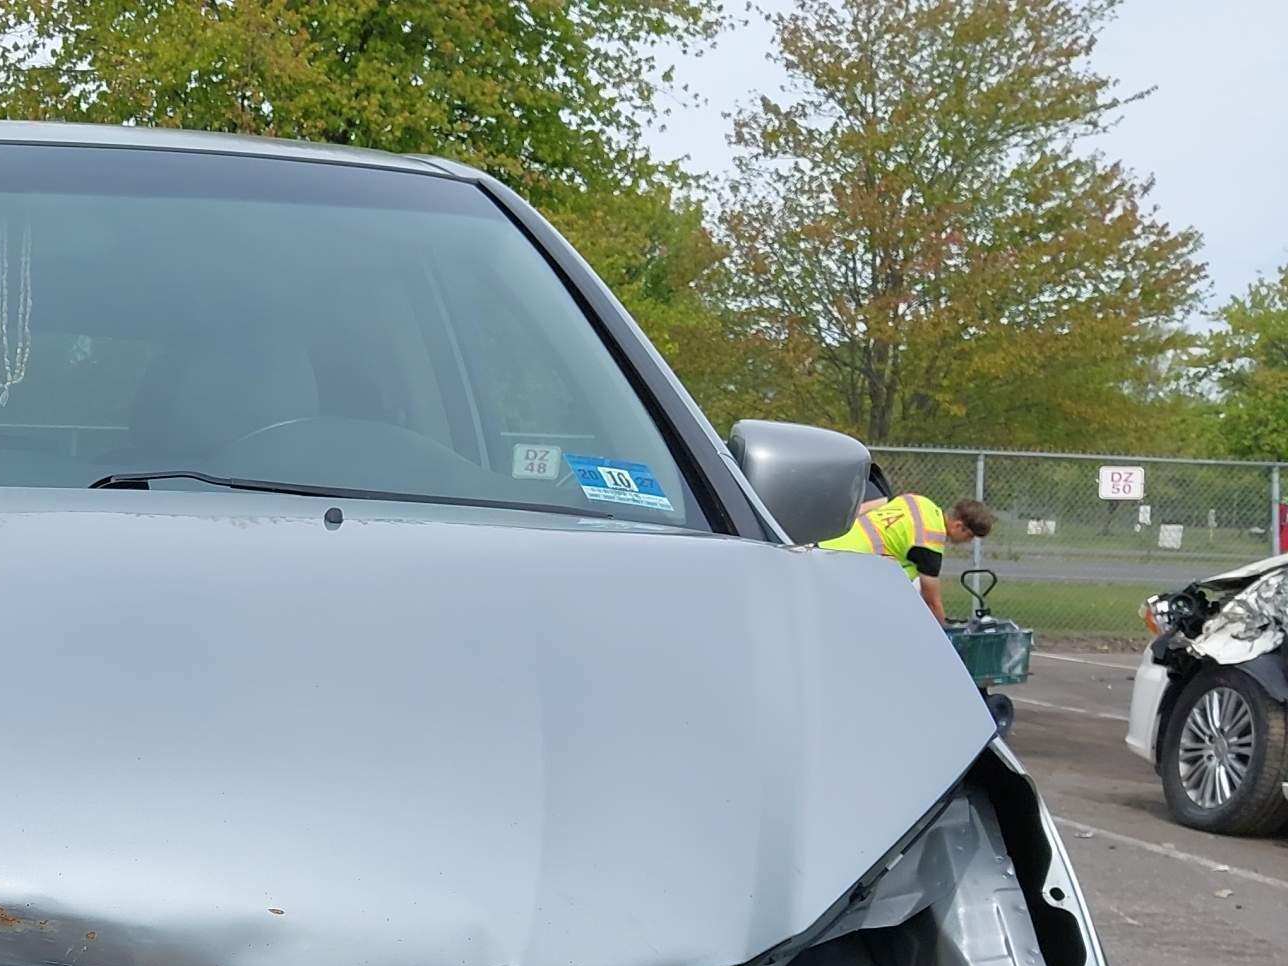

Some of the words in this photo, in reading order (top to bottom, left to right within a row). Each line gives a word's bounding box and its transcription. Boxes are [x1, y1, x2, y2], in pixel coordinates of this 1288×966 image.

[523, 462, 548, 474] 48
[606, 470, 632, 489] 10
[1110, 471, 1134, 483] DZ
[1111, 483, 1132, 495] 50
